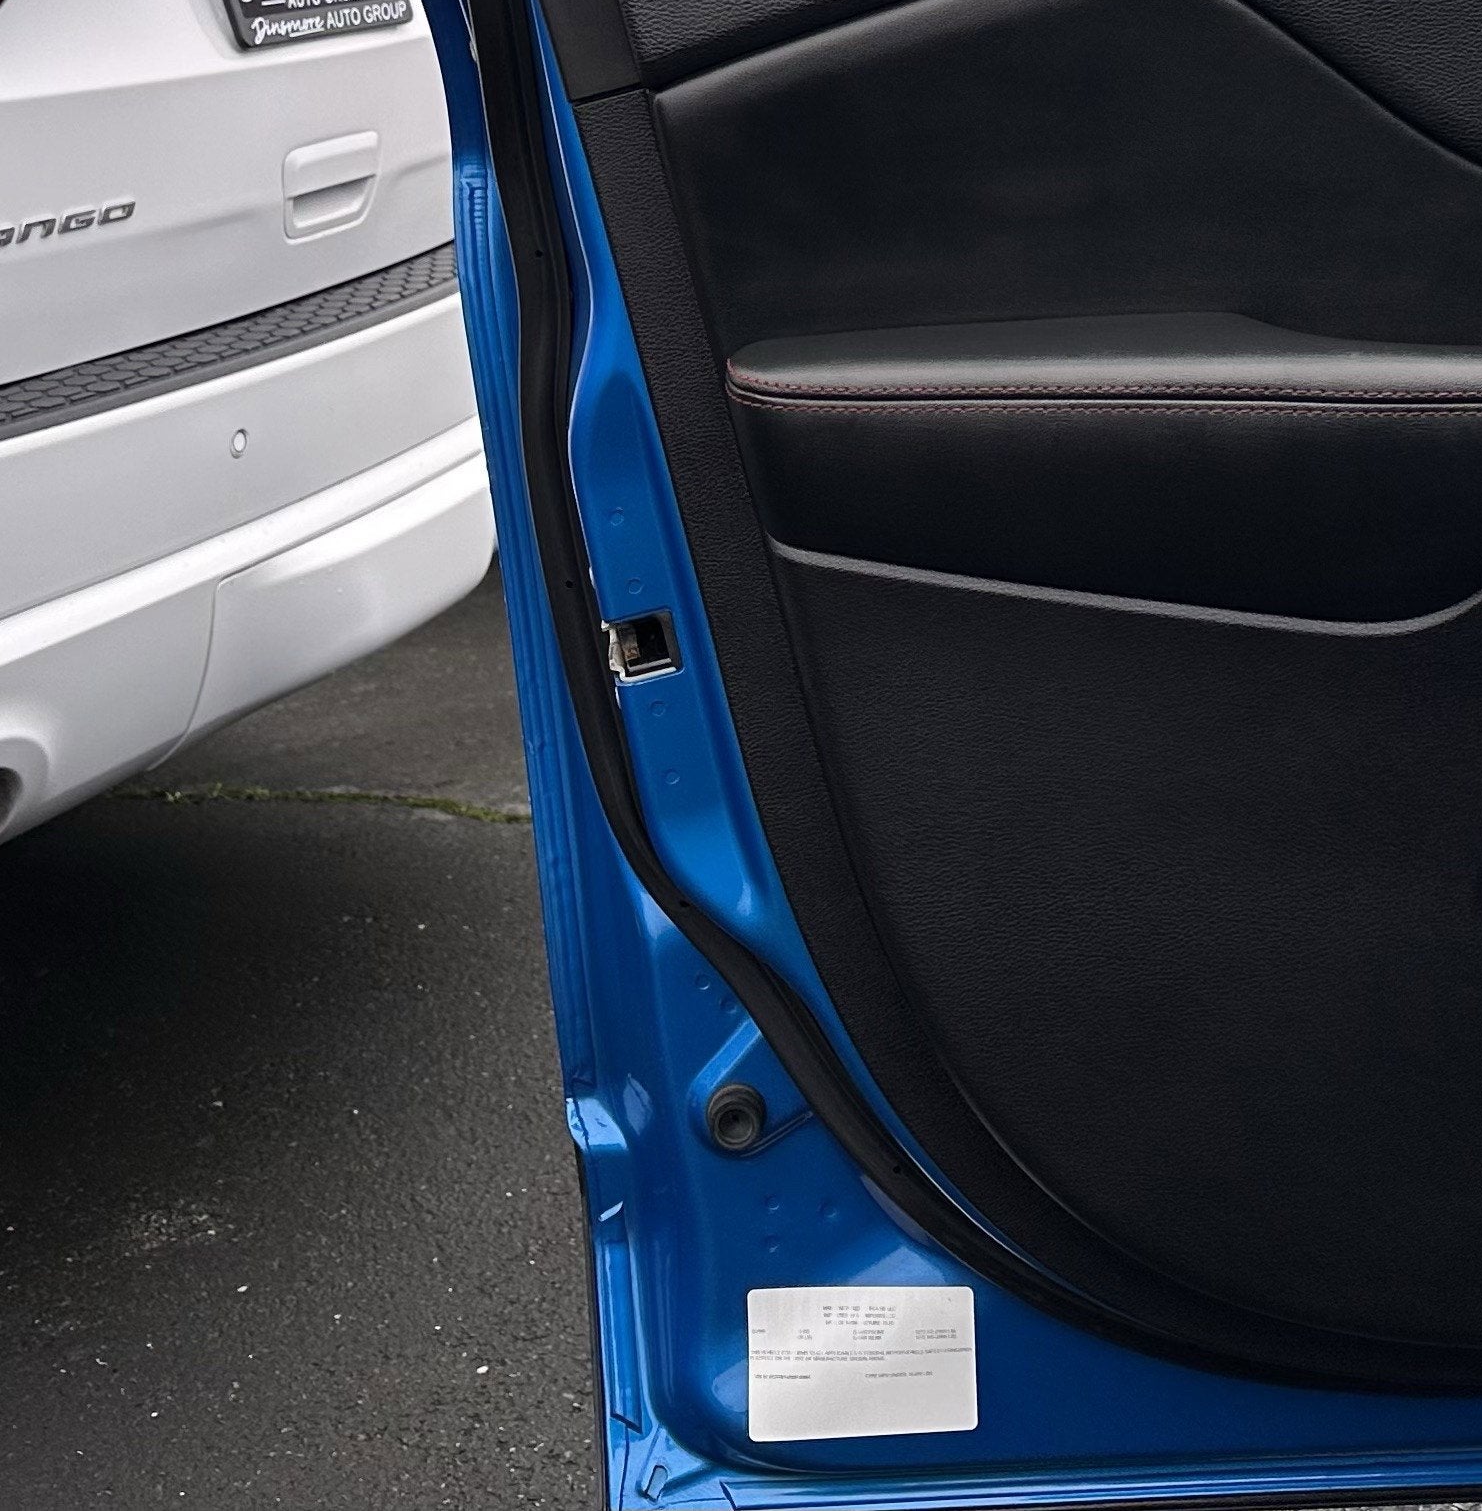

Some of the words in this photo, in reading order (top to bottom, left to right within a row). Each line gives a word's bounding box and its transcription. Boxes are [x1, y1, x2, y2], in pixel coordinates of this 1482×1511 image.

[251, 16, 325, 45] Dinsmore
[327, 7, 362, 30] AUTO
[363, 0, 407, 23] GROUP
